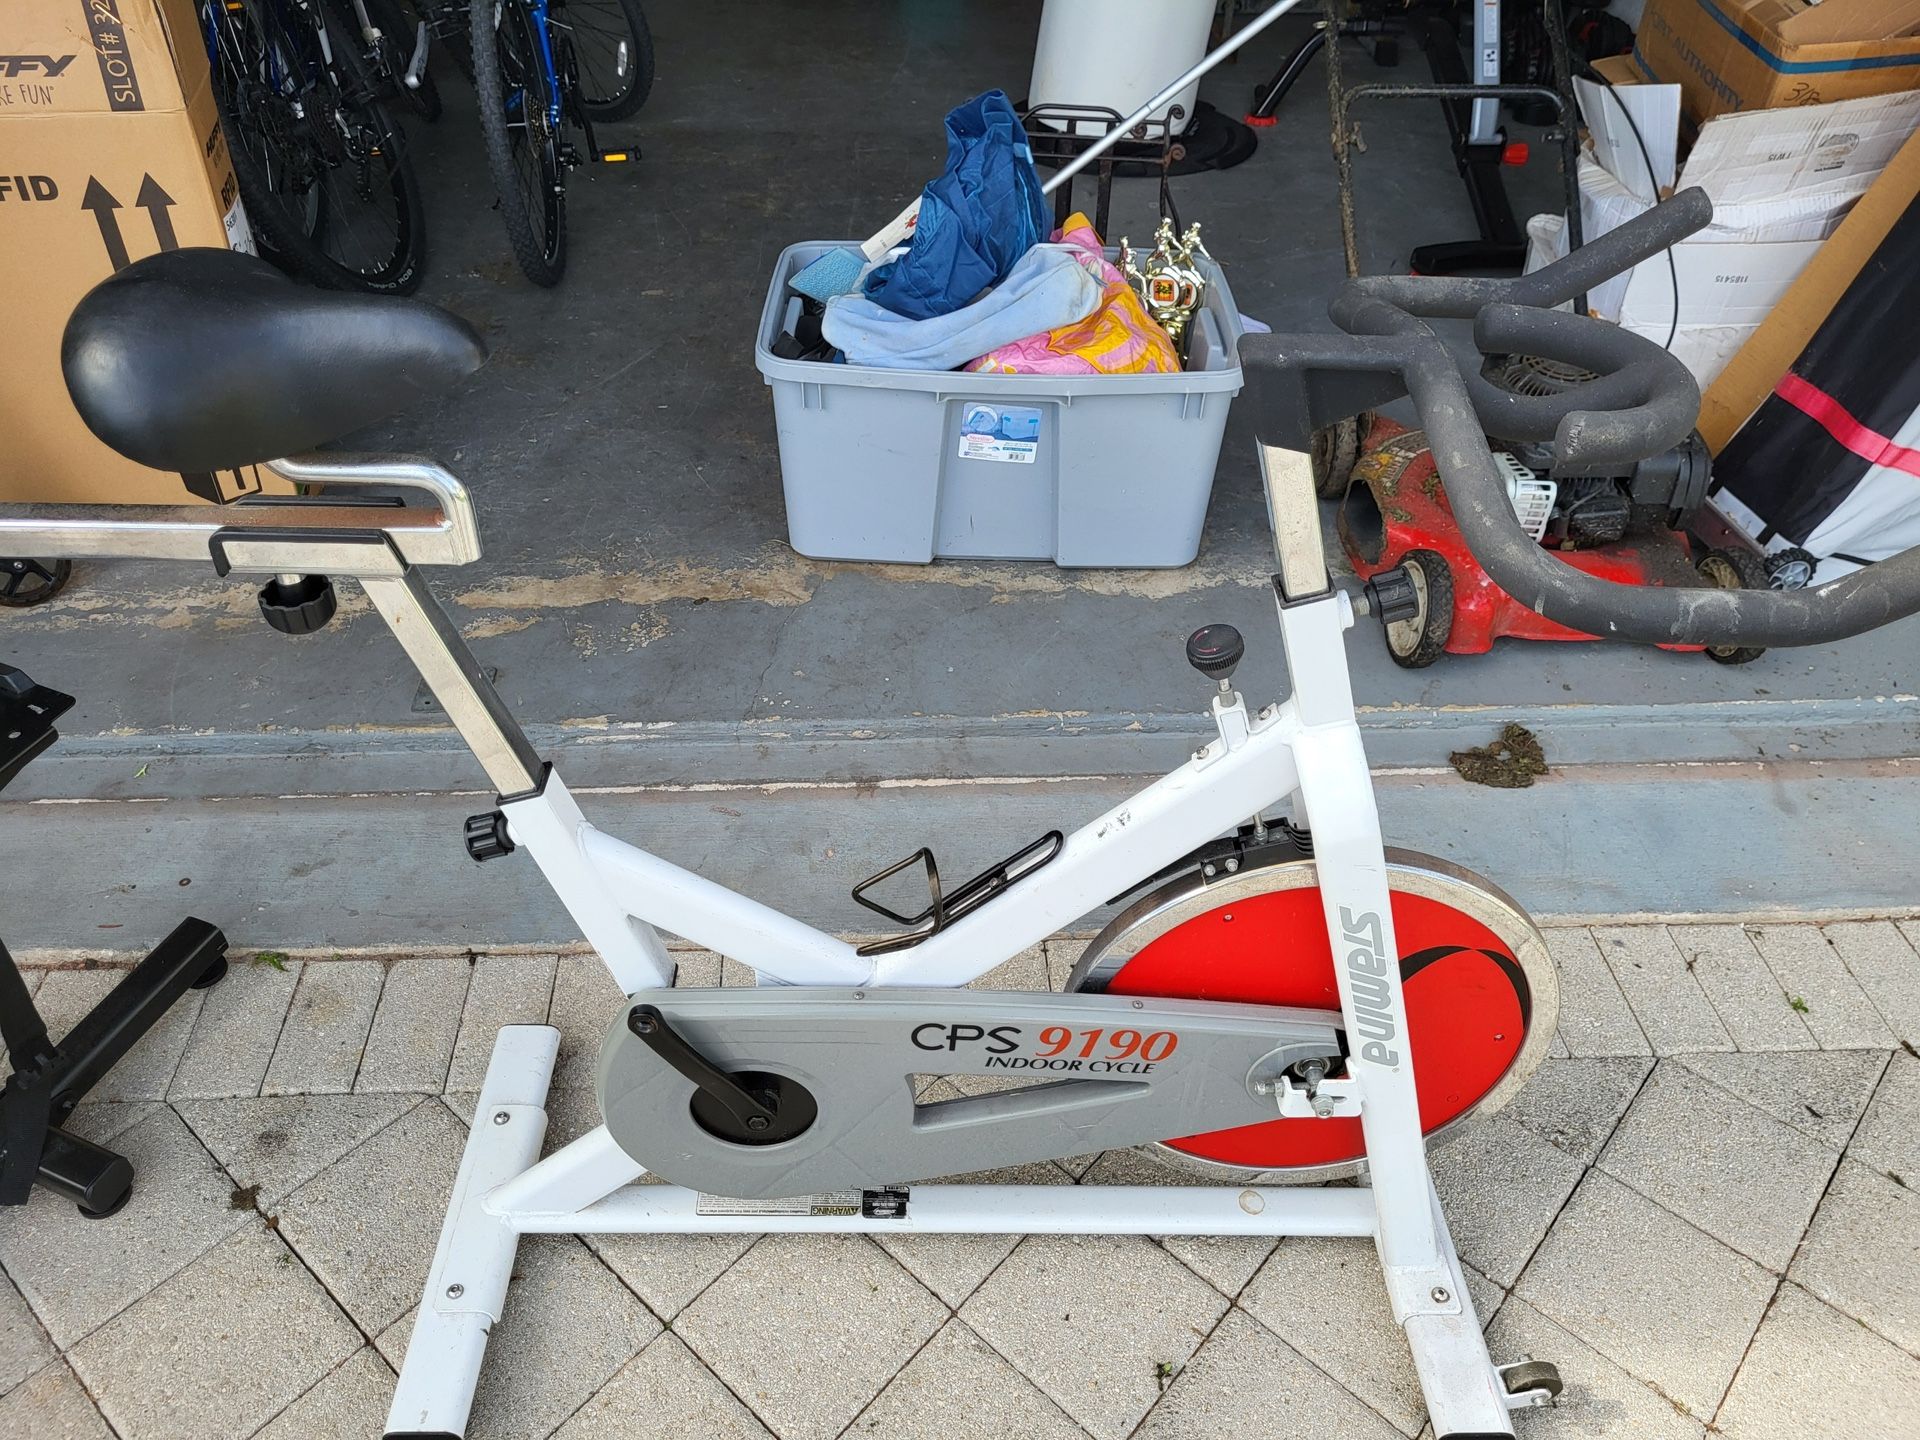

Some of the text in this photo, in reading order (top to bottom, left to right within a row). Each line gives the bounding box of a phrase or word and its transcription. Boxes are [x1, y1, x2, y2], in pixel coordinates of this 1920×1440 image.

[0, 55, 77, 77] FY
[1672, 37, 1744, 112] AUTHORITY
[221, 171, 236, 211] RFID
[910, 1023, 1178, 1062] CPS 9190
[985, 1056, 1156, 1074] INDOOR CYCLE
[812, 1206, 853, 1216] WARNING
